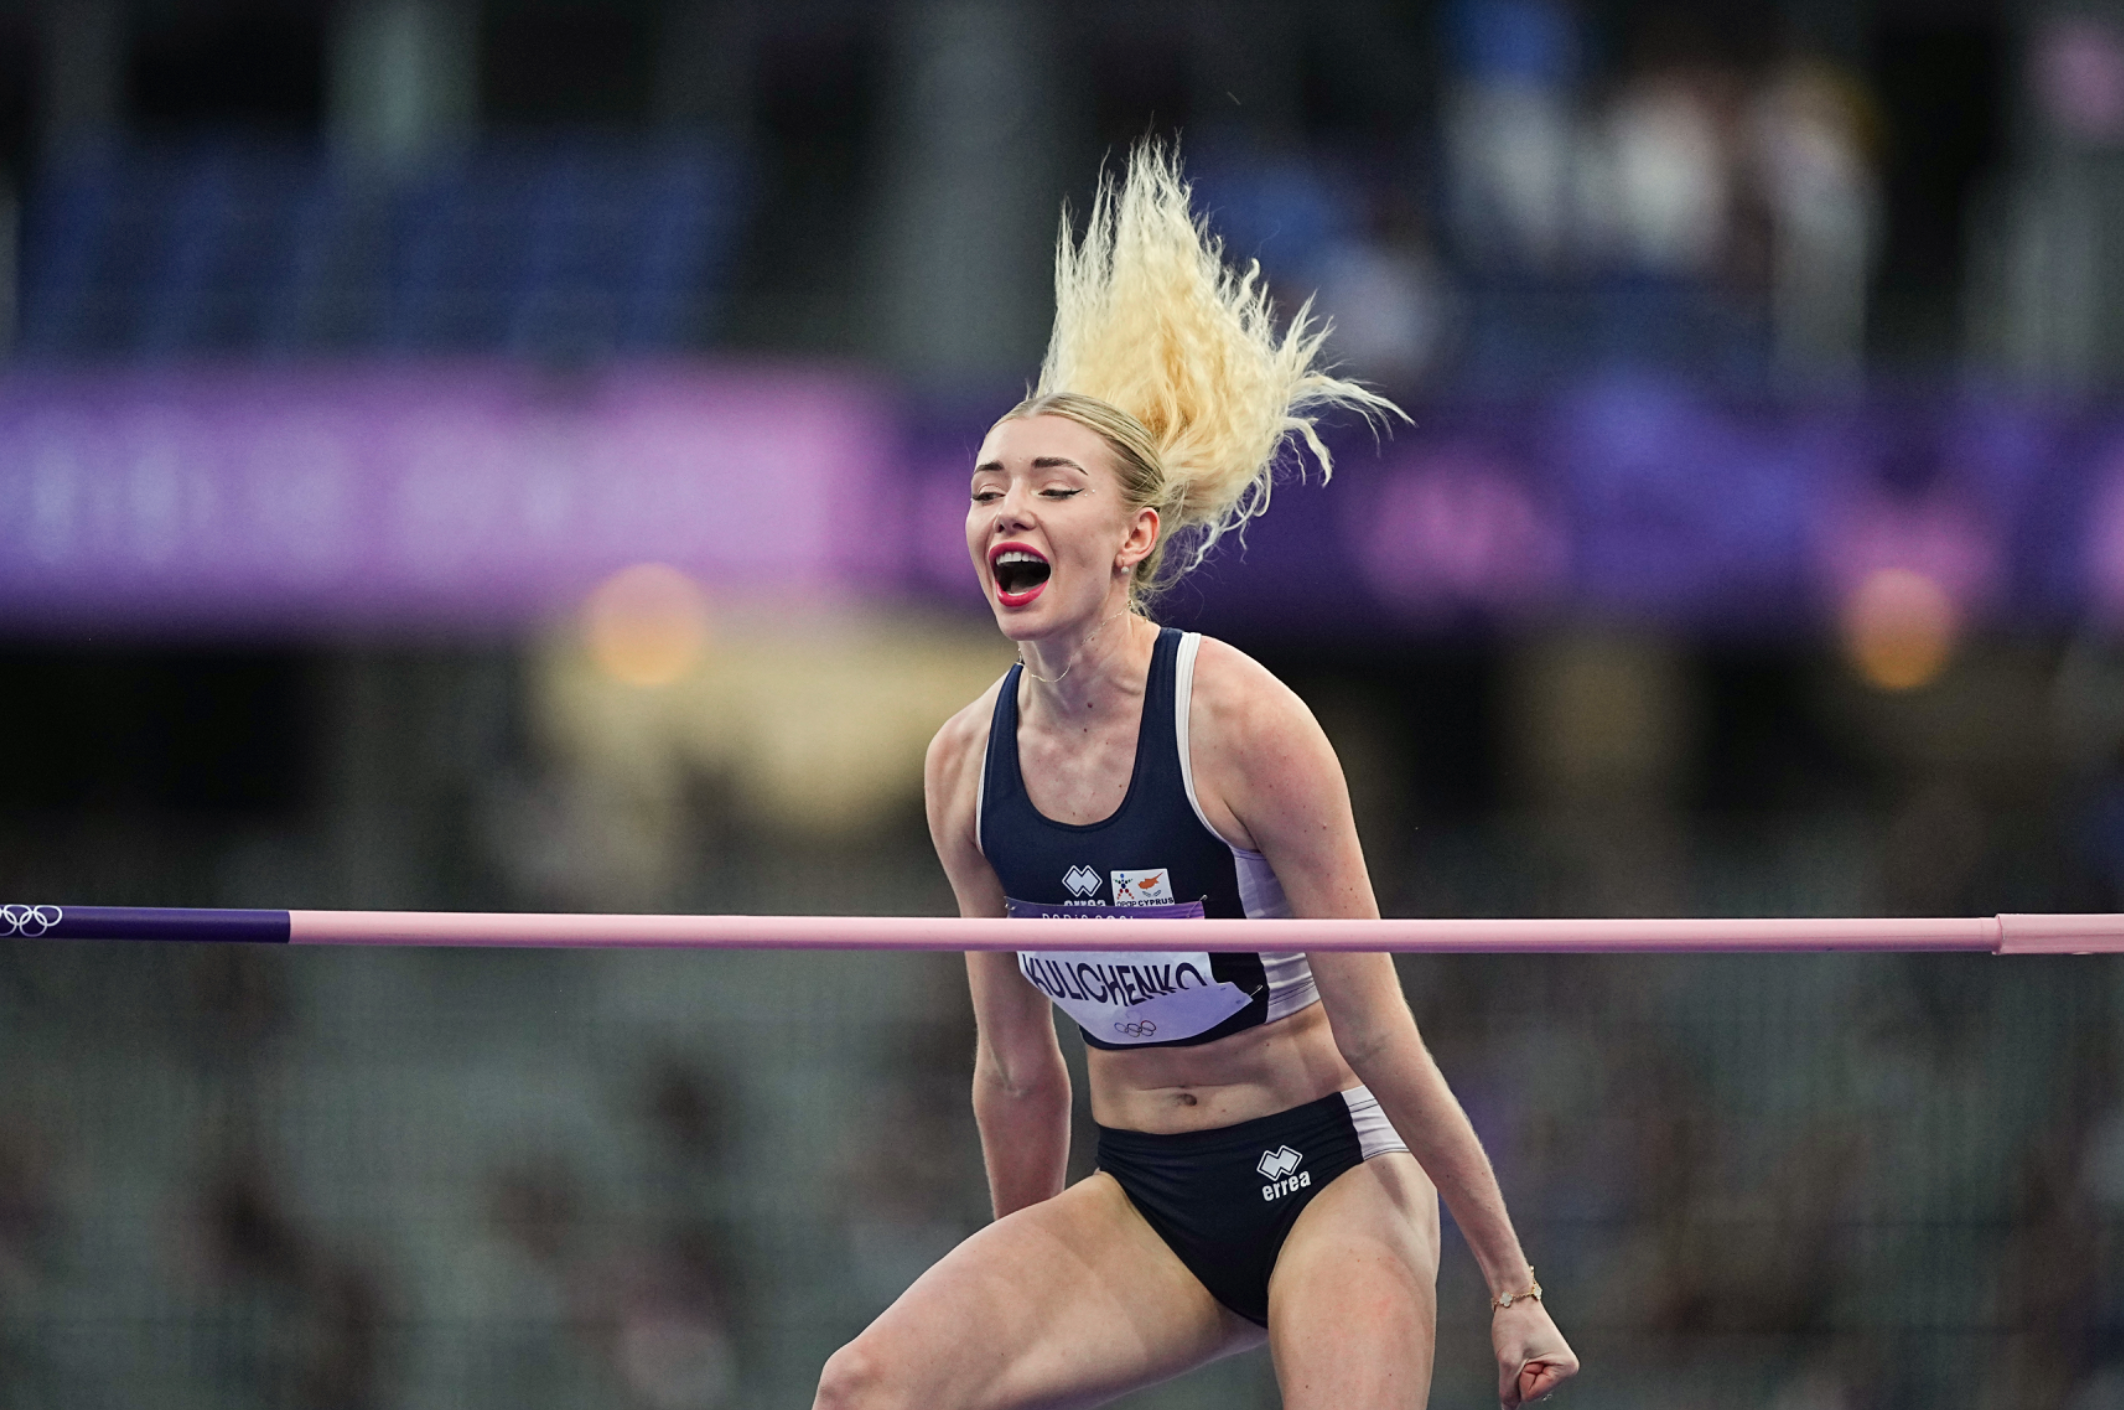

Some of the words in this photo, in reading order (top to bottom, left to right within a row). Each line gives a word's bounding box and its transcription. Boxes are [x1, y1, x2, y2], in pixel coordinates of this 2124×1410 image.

[1138, 897, 1174, 907] CYPRUS
[1022, 953, 1208, 1007] KULICHENKO
[1262, 1171, 1311, 1201] errea
